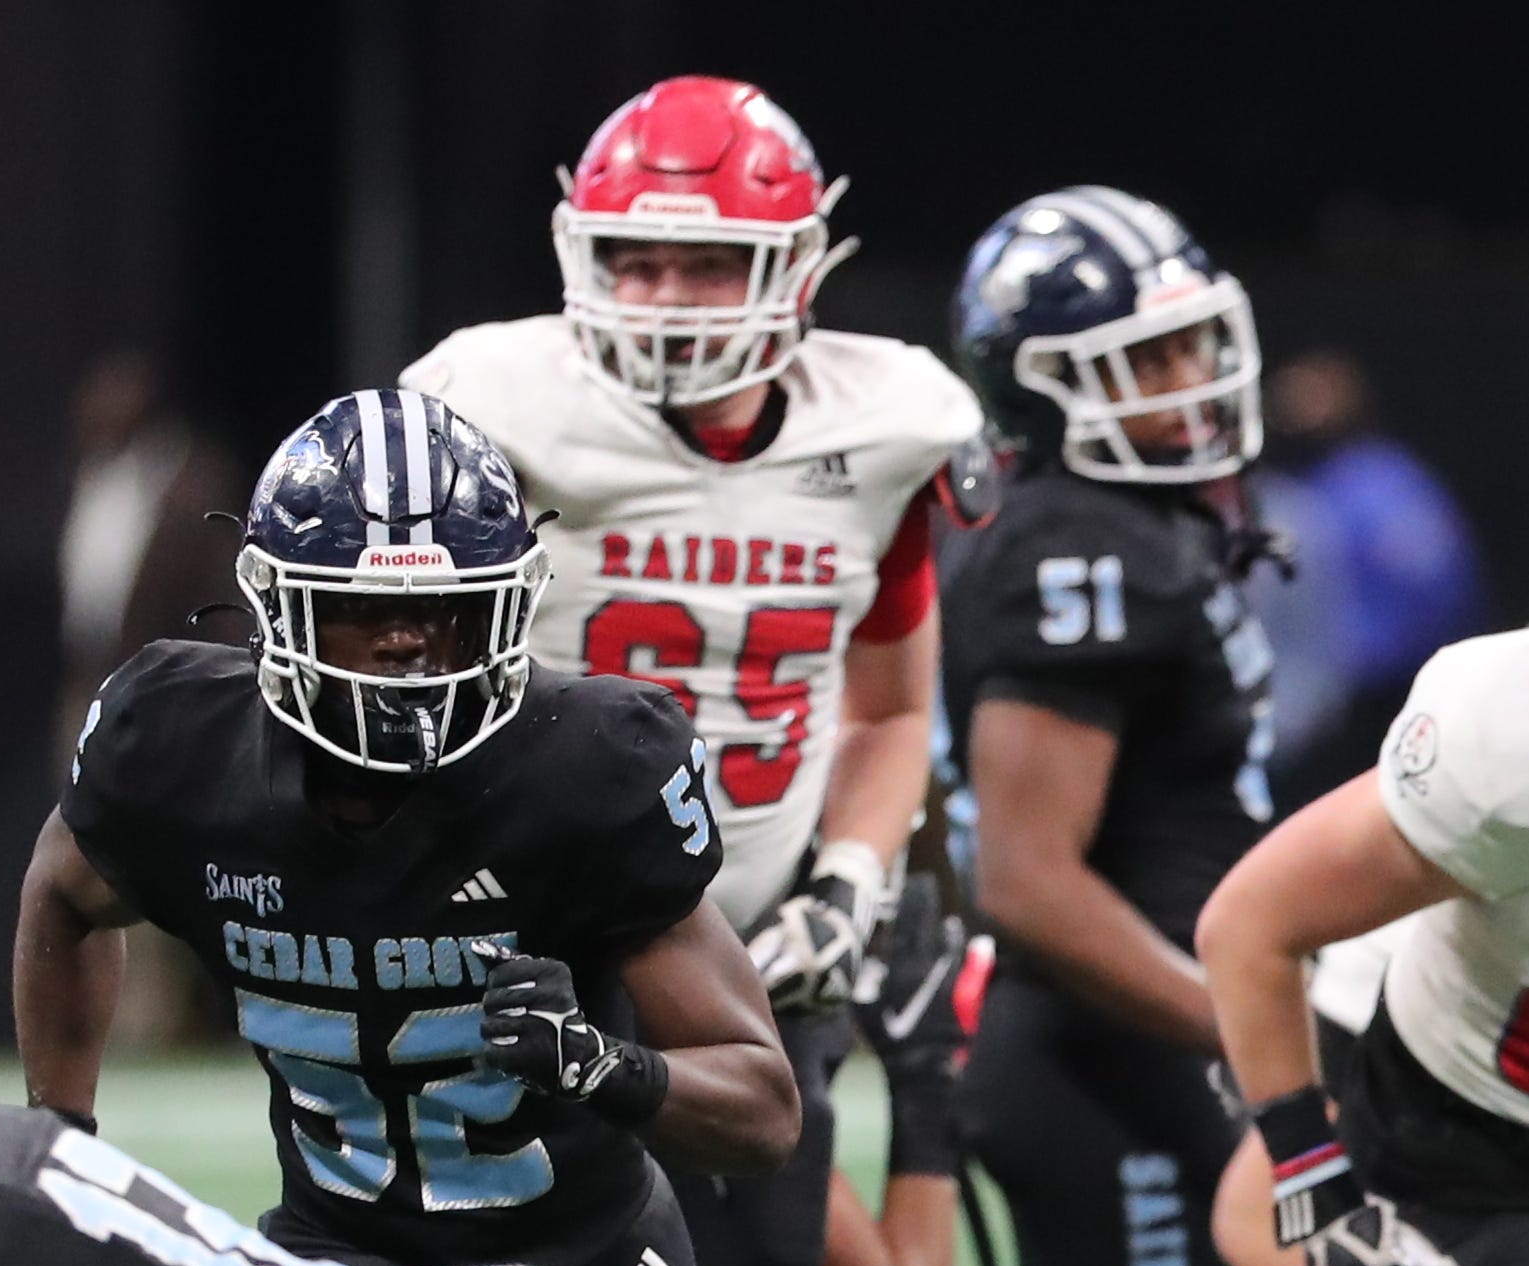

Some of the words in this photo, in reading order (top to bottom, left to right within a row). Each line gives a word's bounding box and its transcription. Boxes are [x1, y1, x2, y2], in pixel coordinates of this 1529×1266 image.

[369, 551, 443, 567] Riddell
[600, 531, 837, 585] RAIDERS
[1036, 555, 1126, 643] 51
[382, 721, 416, 734] Ridd
[582, 592, 837, 808] 65
[222, 920, 360, 991] CEDAR
[236, 986, 555, 1212] 52
